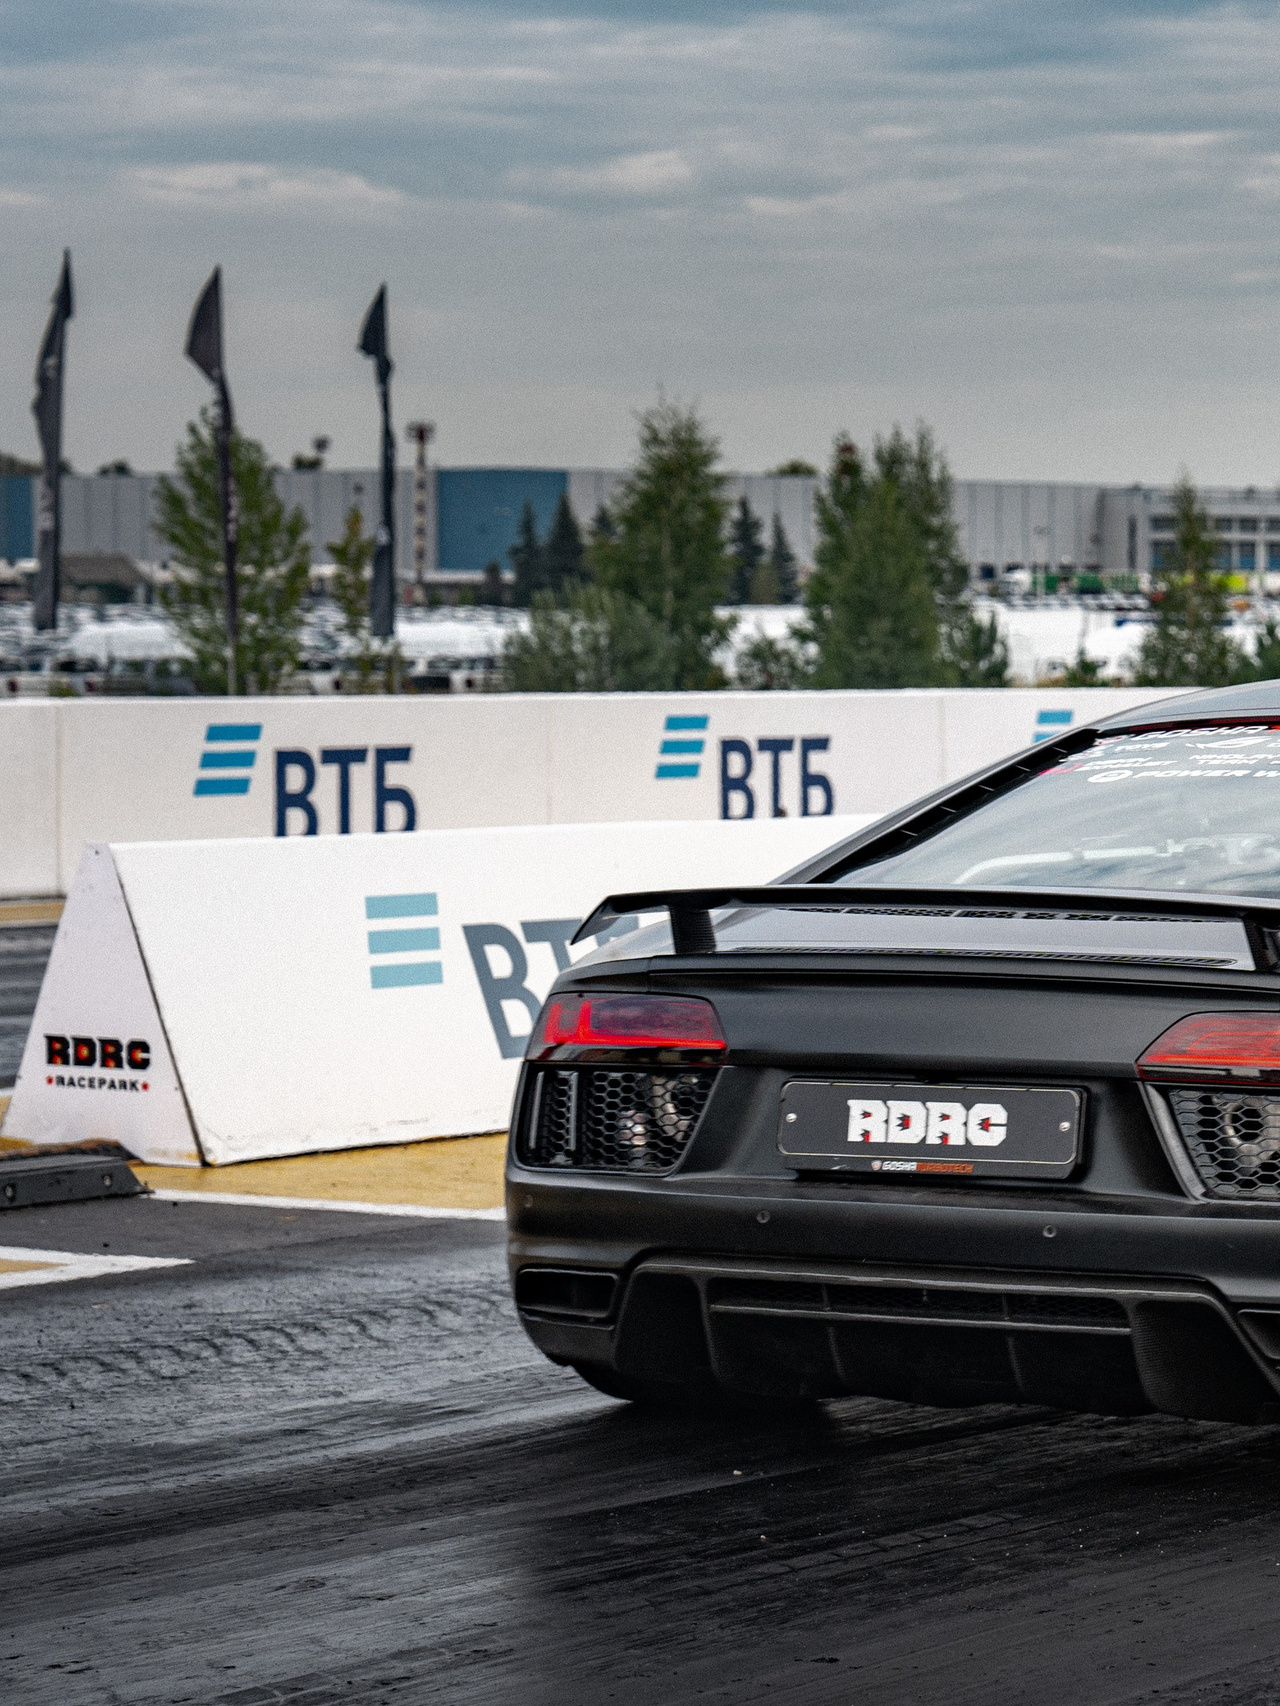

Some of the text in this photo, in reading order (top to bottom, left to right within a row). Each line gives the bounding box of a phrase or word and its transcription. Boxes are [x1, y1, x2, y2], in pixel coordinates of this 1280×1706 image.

[273, 746, 417, 837] ВТБ
[719, 737, 834, 820] ВТБ
[1133, 769, 1251, 778] POWER
[44, 1034, 150, 1070] RDRC
[55, 1075, 139, 1091] RACEPARK
[847, 1099, 1008, 1147] RDRC
